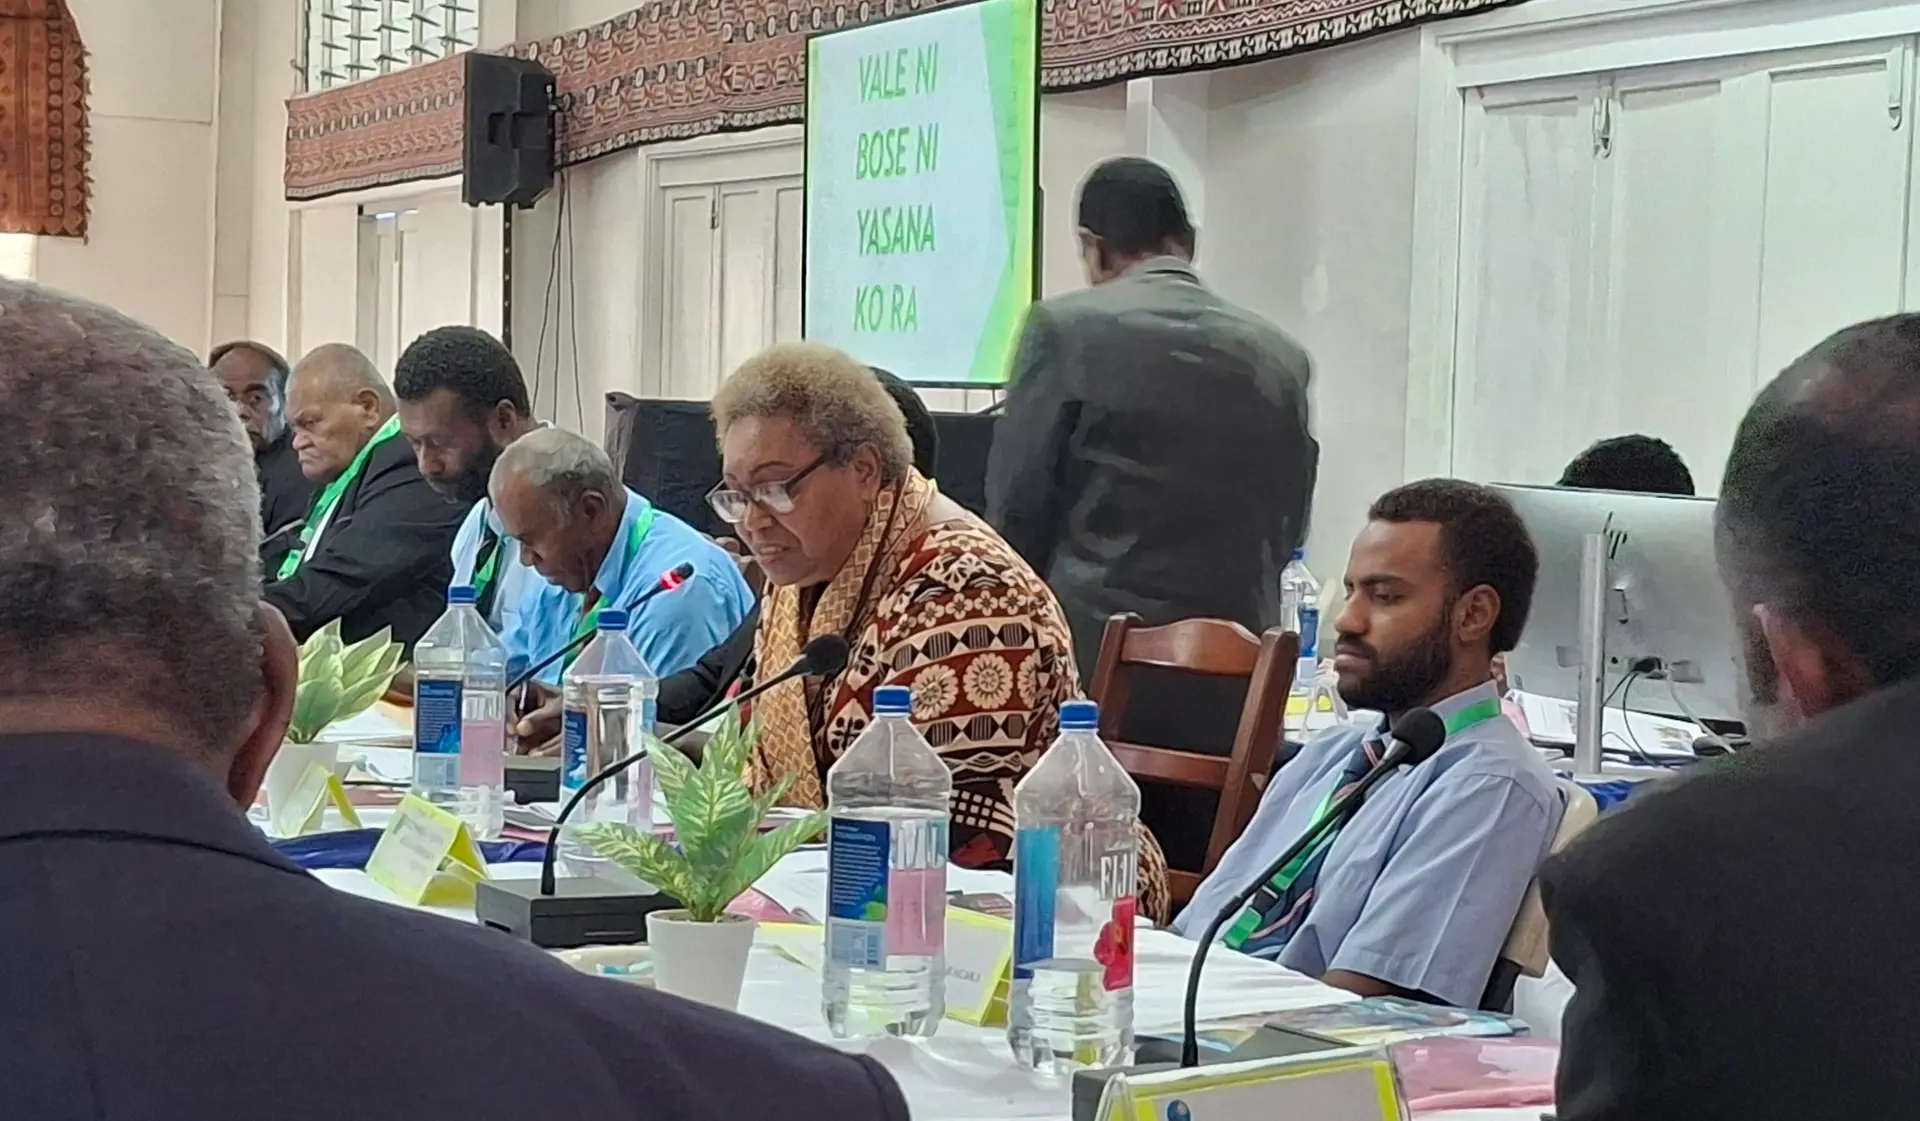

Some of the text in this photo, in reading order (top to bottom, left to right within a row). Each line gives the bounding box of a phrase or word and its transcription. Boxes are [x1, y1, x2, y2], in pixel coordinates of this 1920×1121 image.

[858, 41, 939, 103] VALE NI
[856, 121, 939, 180] BOSE NI
[857, 201, 935, 257] YASANA
[854, 283, 917, 333] KO RA
[1100, 852, 1133, 899] FIJI
